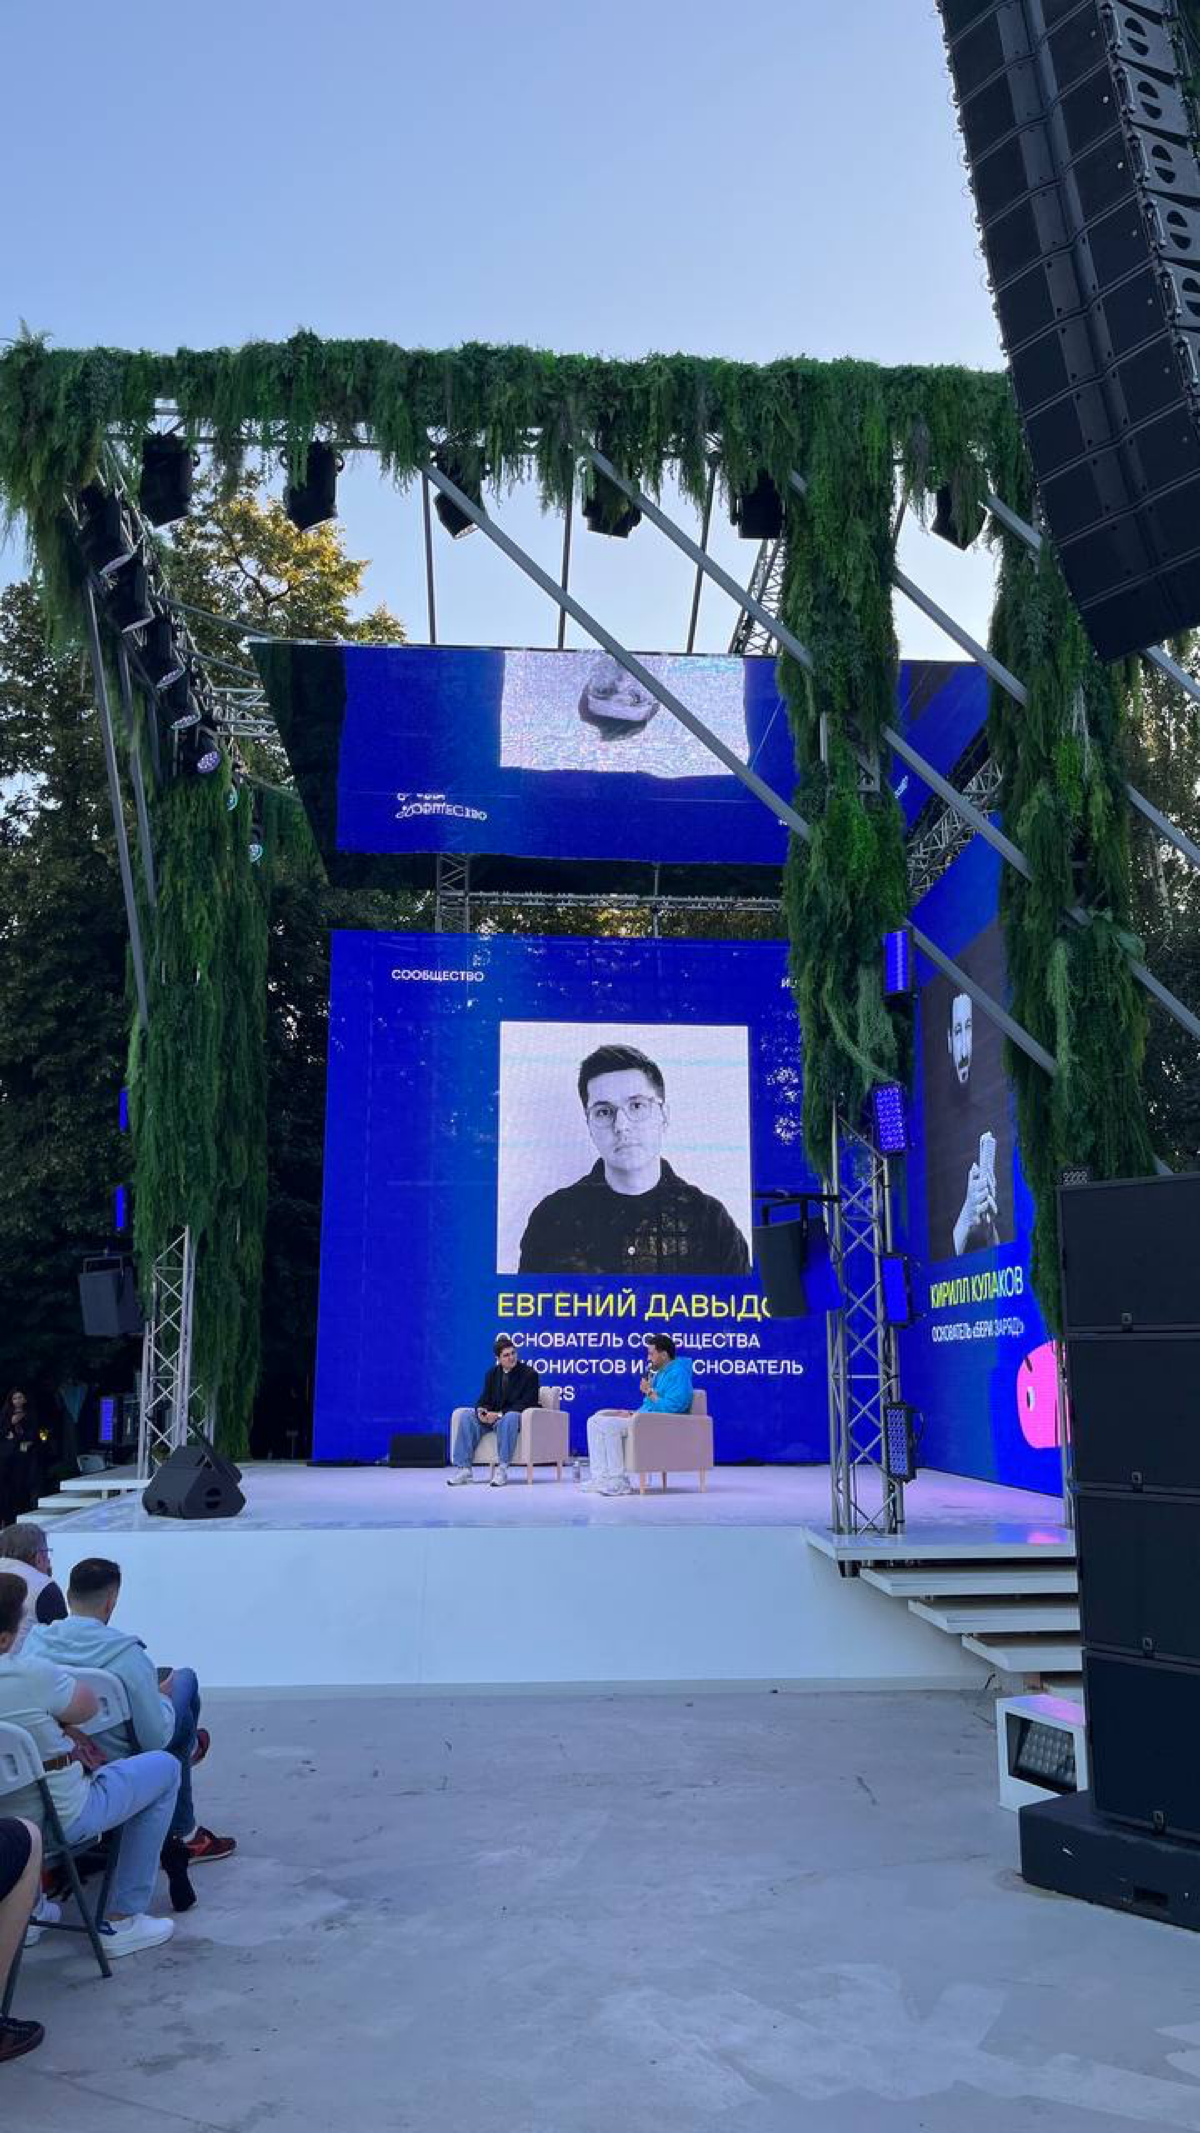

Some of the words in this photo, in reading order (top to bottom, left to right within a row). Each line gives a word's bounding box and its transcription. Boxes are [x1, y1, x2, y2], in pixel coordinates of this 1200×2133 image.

[391, 969, 484, 982] СООБЩЕСТВО
[930, 1277, 970, 1309] КИРИЛЛ
[971, 1266, 1023, 1303] КУЛАКОВ
[497, 1287, 637, 1318] ЕВГЕНИЙ
[627, 1332, 760, 1350] СОБЩЕСТВА
[631, 1359, 644, 1374] И
